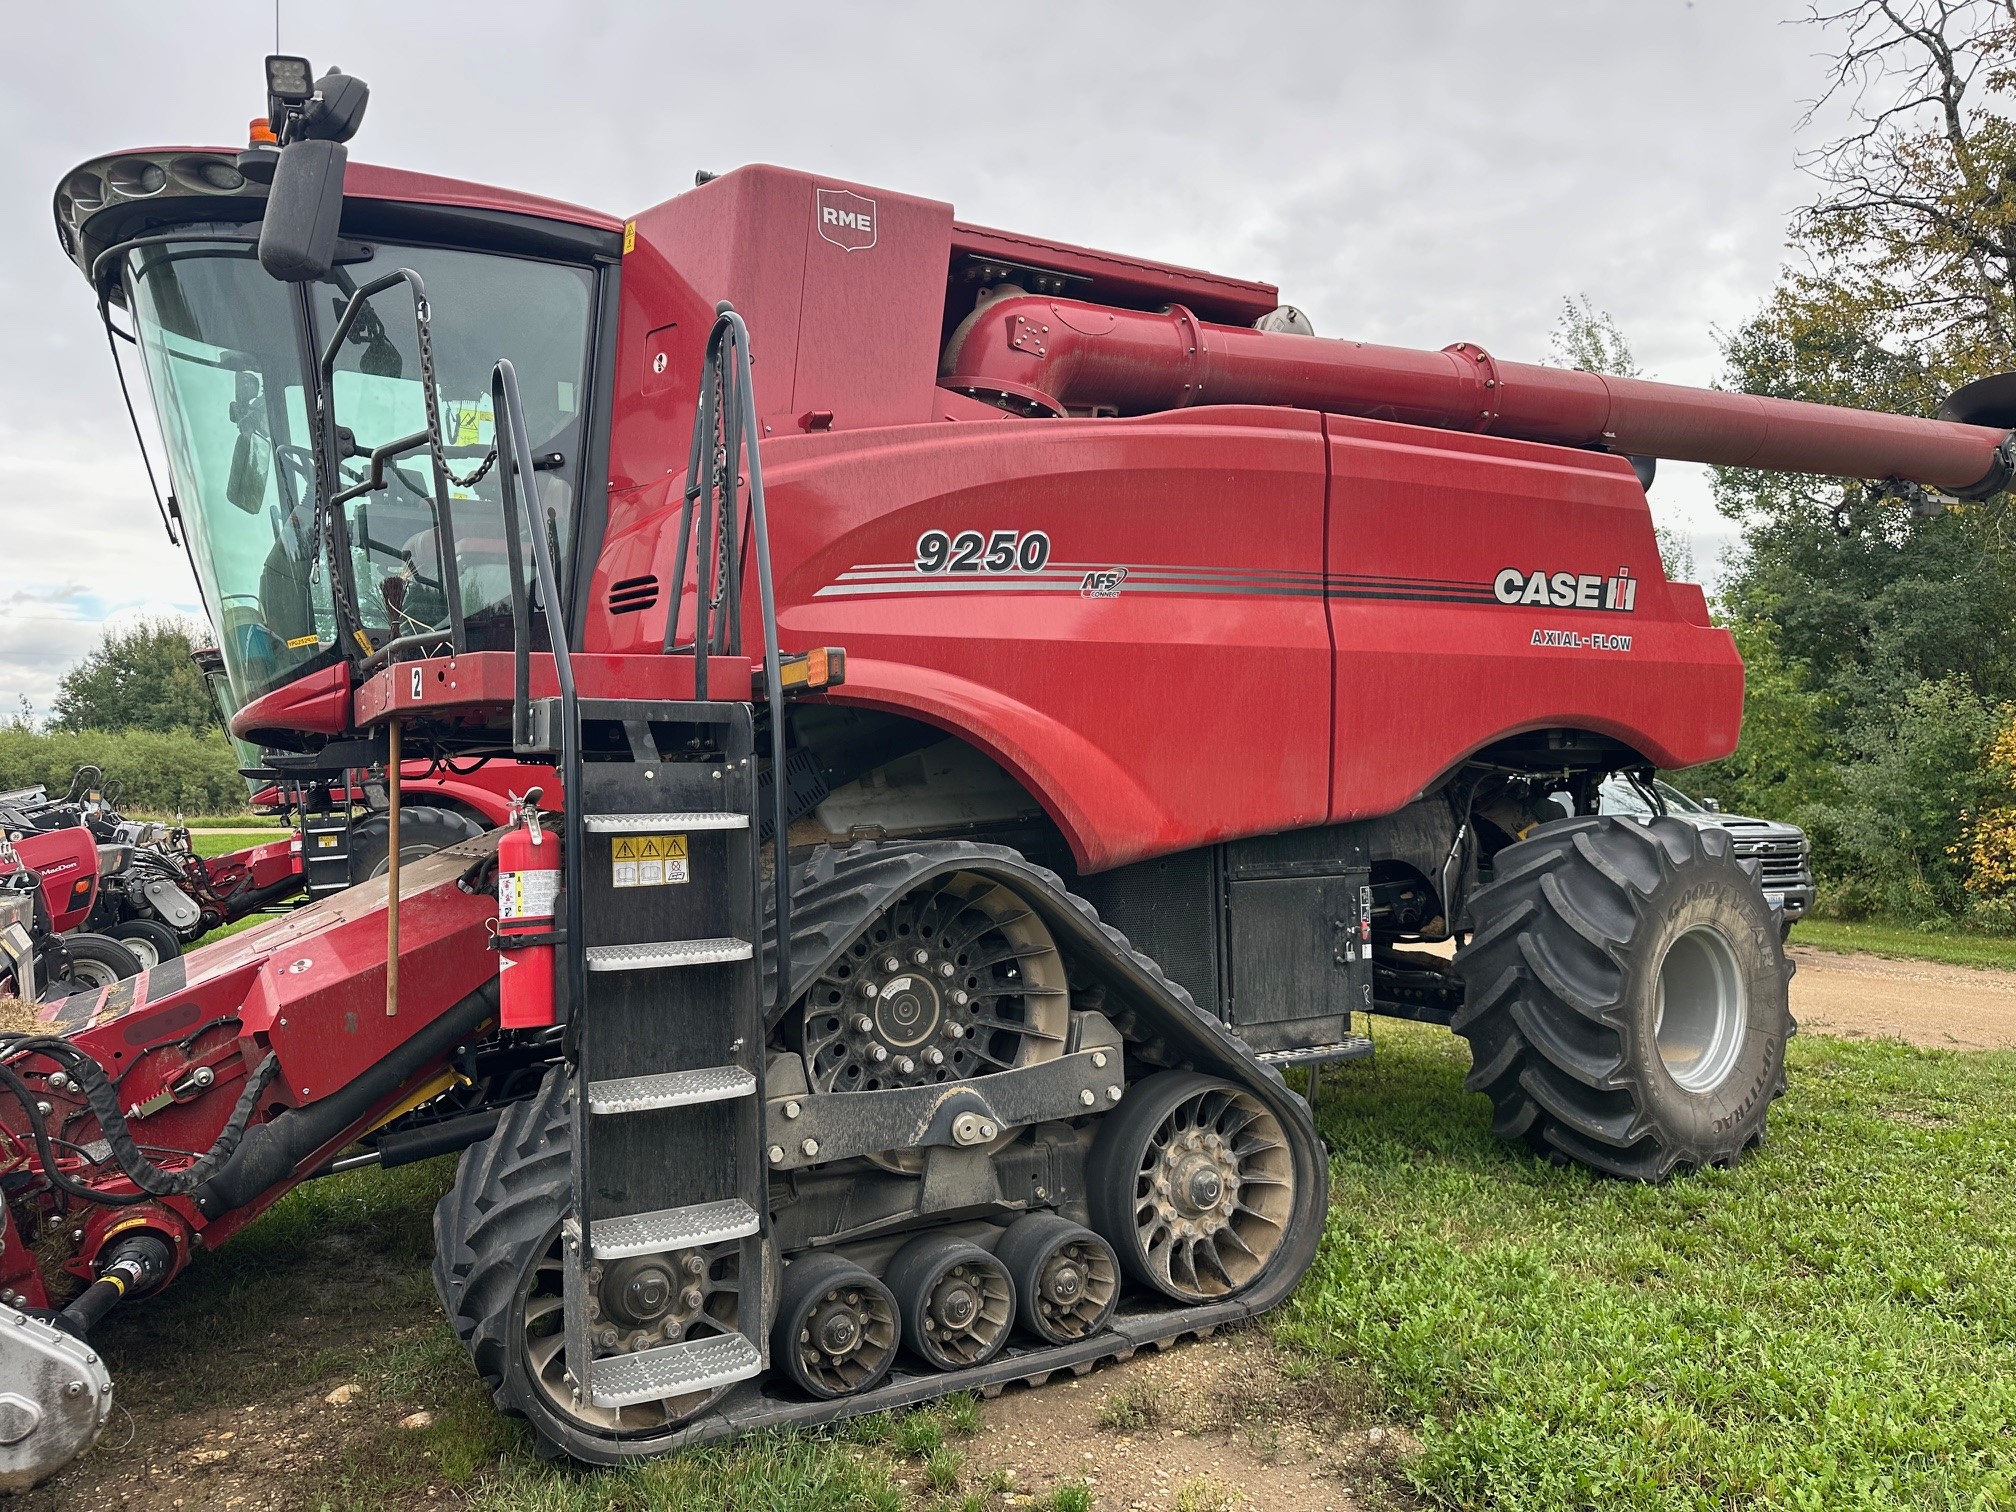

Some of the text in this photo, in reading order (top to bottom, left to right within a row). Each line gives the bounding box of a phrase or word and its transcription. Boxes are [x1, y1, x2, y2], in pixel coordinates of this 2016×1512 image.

[822, 206, 872, 232] RME
[914, 529, 1050, 574] 9250
[1080, 571, 1118, 590] AFS
[1091, 590, 1120, 598] CONNECT
[1494, 567, 1602, 608] CASE
[1531, 629, 1632, 651] AXIAL-FLOW
[413, 669, 421, 697] 2
[41, 862, 77, 876] MacDon
[1667, 881, 1775, 967] GOODYEAR
[1712, 1038, 1775, 1135] OPTITRAC
